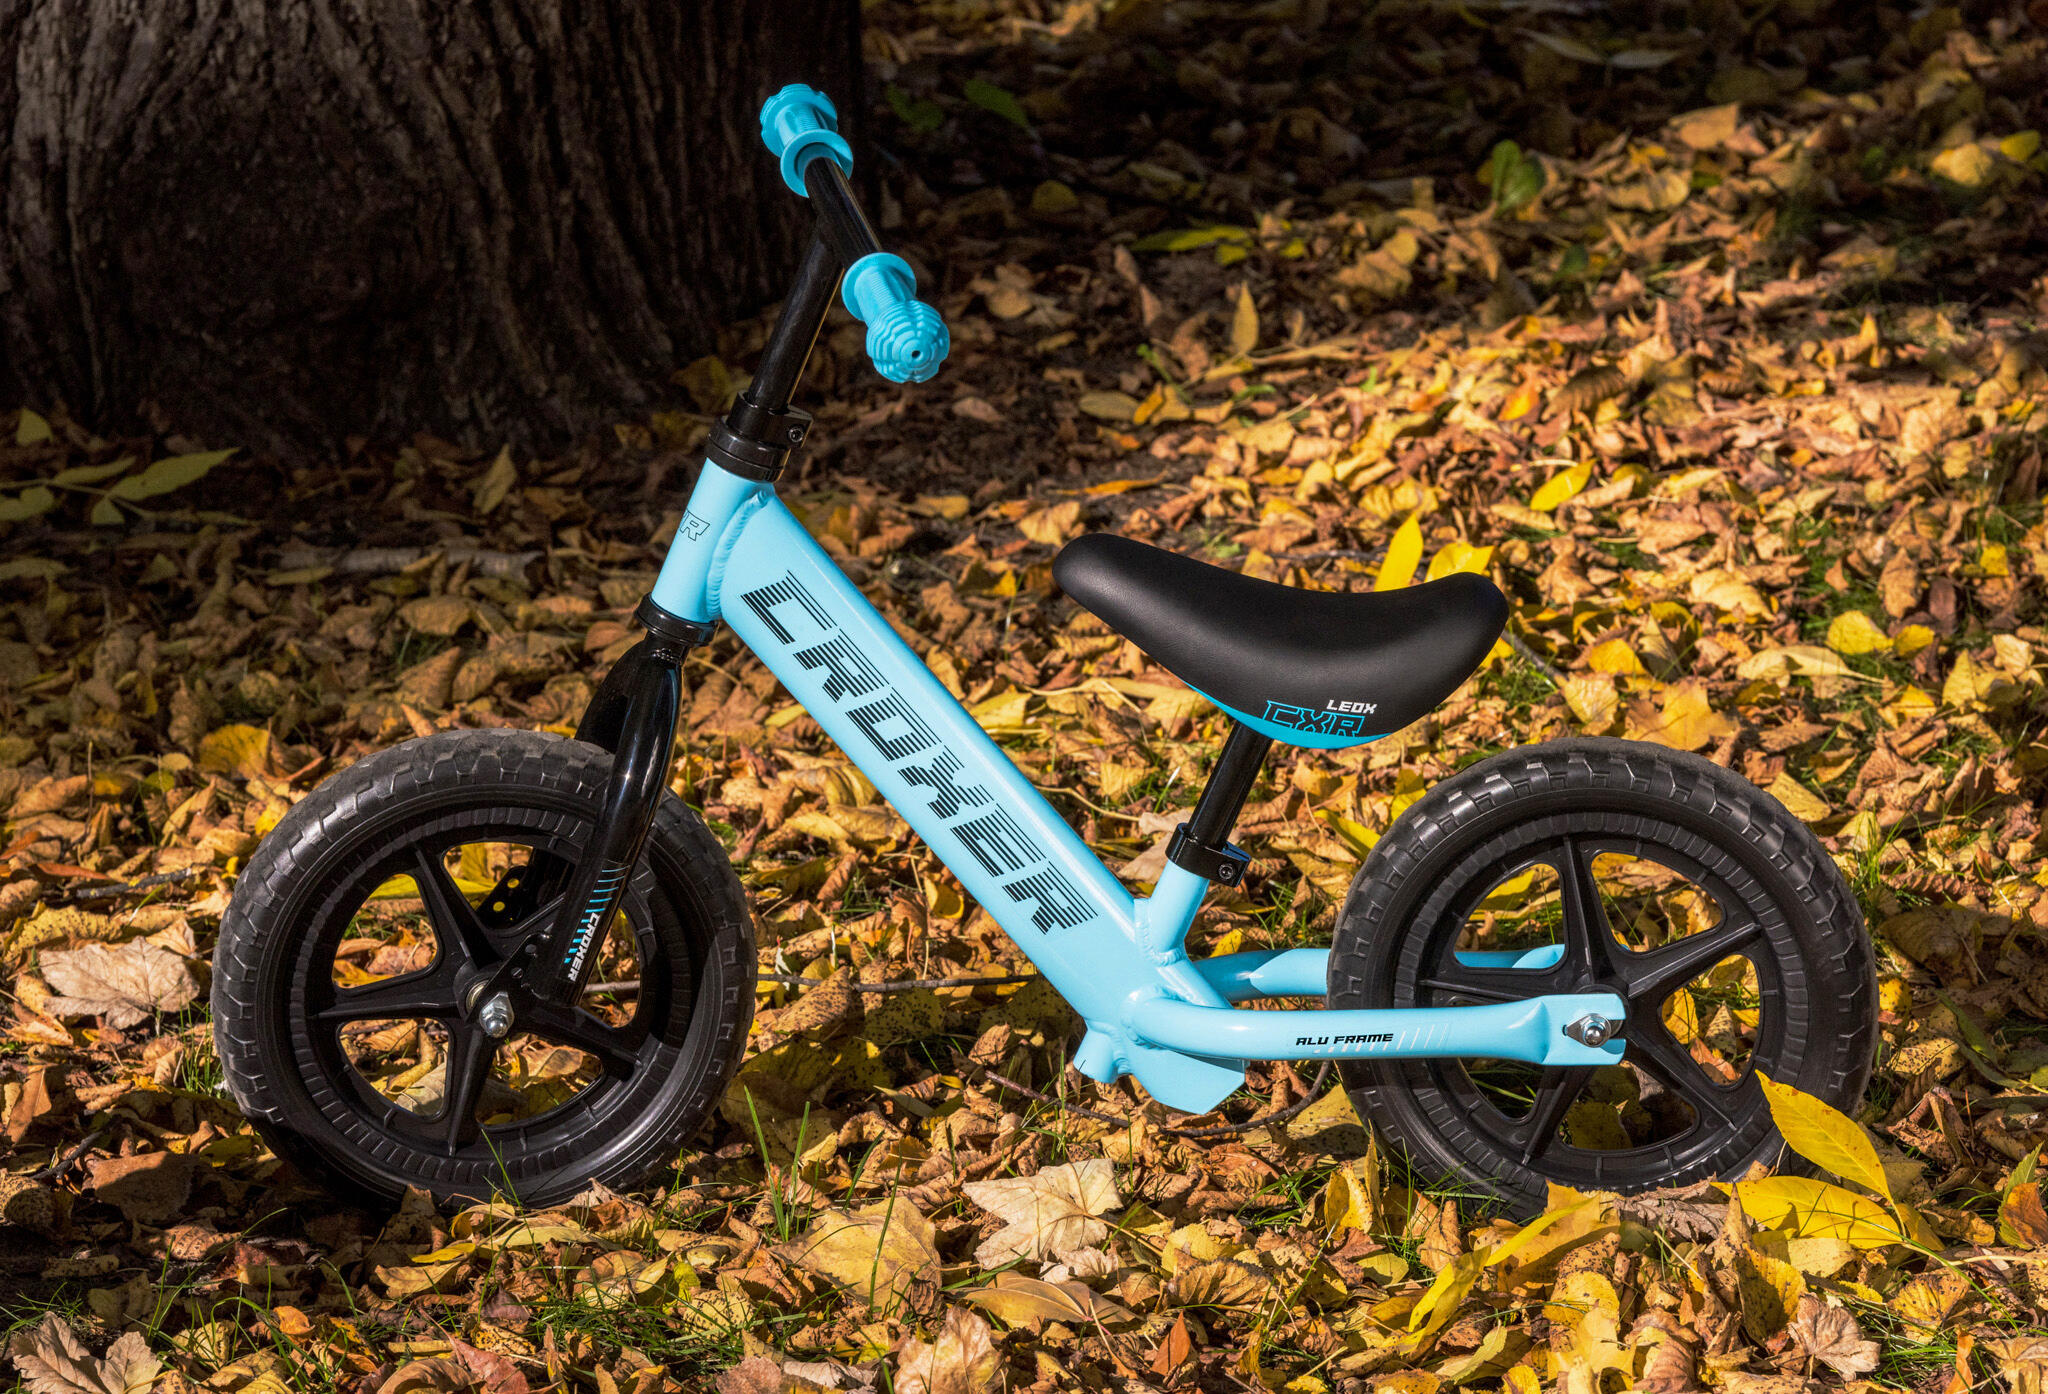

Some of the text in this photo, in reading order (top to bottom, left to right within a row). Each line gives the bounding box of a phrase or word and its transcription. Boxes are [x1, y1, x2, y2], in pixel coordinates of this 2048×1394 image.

[1262, 699, 1366, 738] CXR
[1326, 699, 1378, 715] LEOX
[740, 569, 1099, 935] CROXER
[567, 911, 600, 982] CROXER
[1295, 1033, 1394, 1046] ALU FRAME
